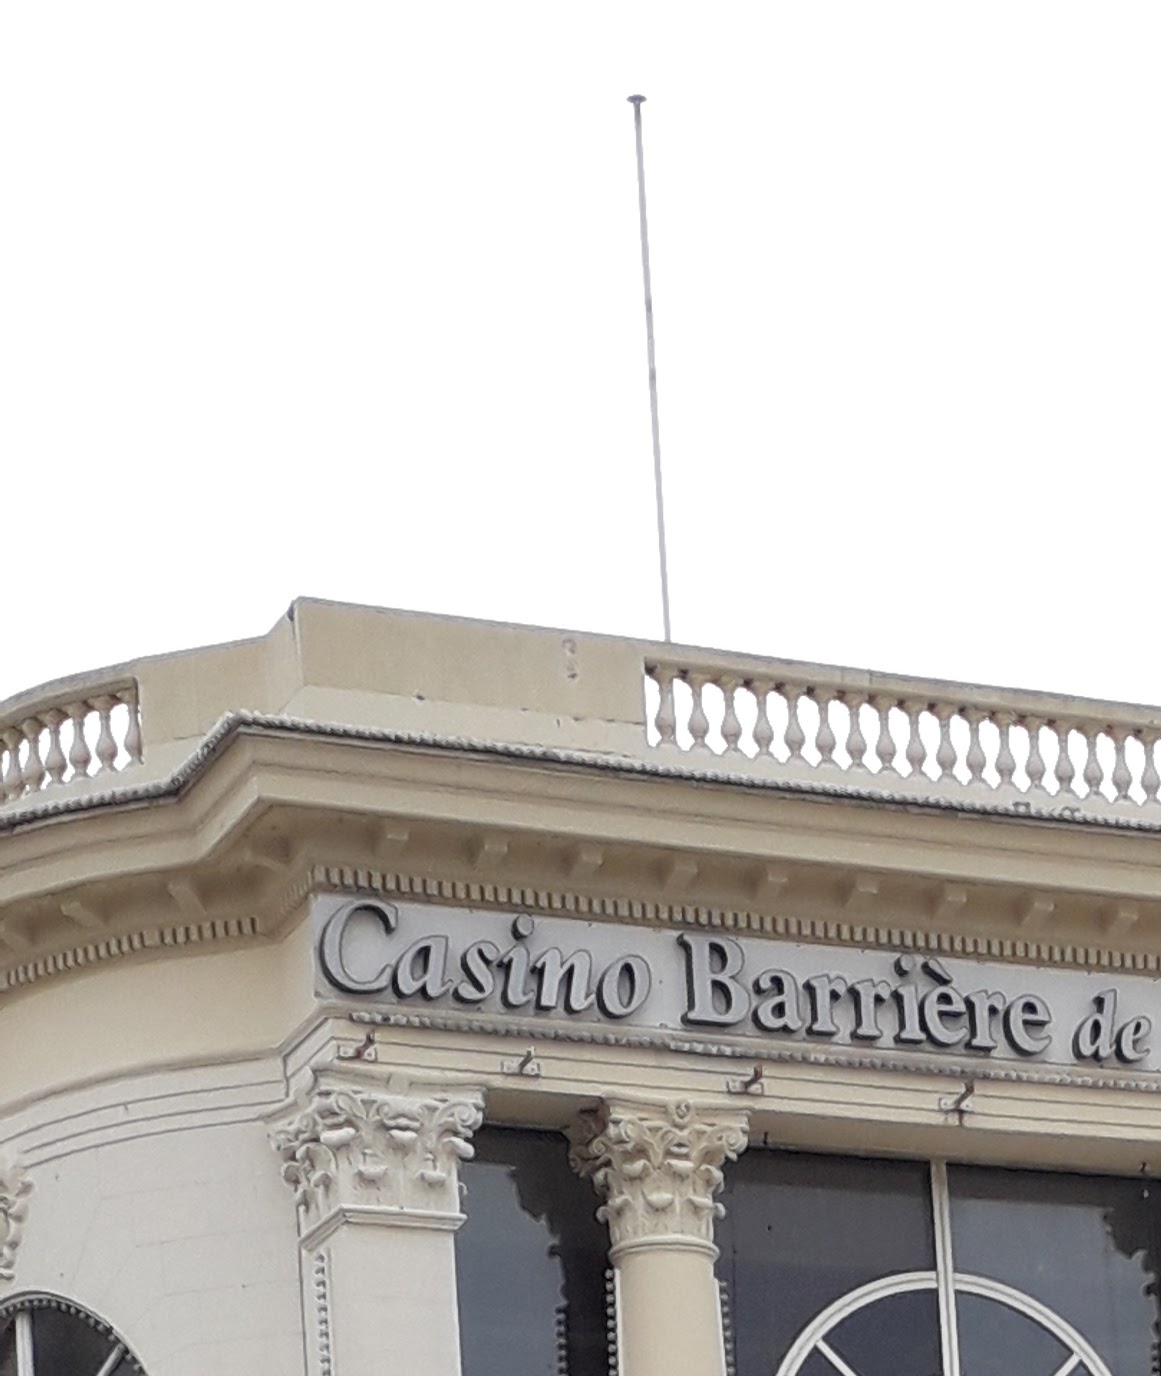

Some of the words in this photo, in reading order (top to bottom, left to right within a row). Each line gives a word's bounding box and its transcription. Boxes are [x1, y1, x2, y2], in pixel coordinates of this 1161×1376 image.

[319, 902, 652, 1019] Casino
[675, 932, 1052, 1055] Barrière
[1073, 987, 1152, 1066] de
